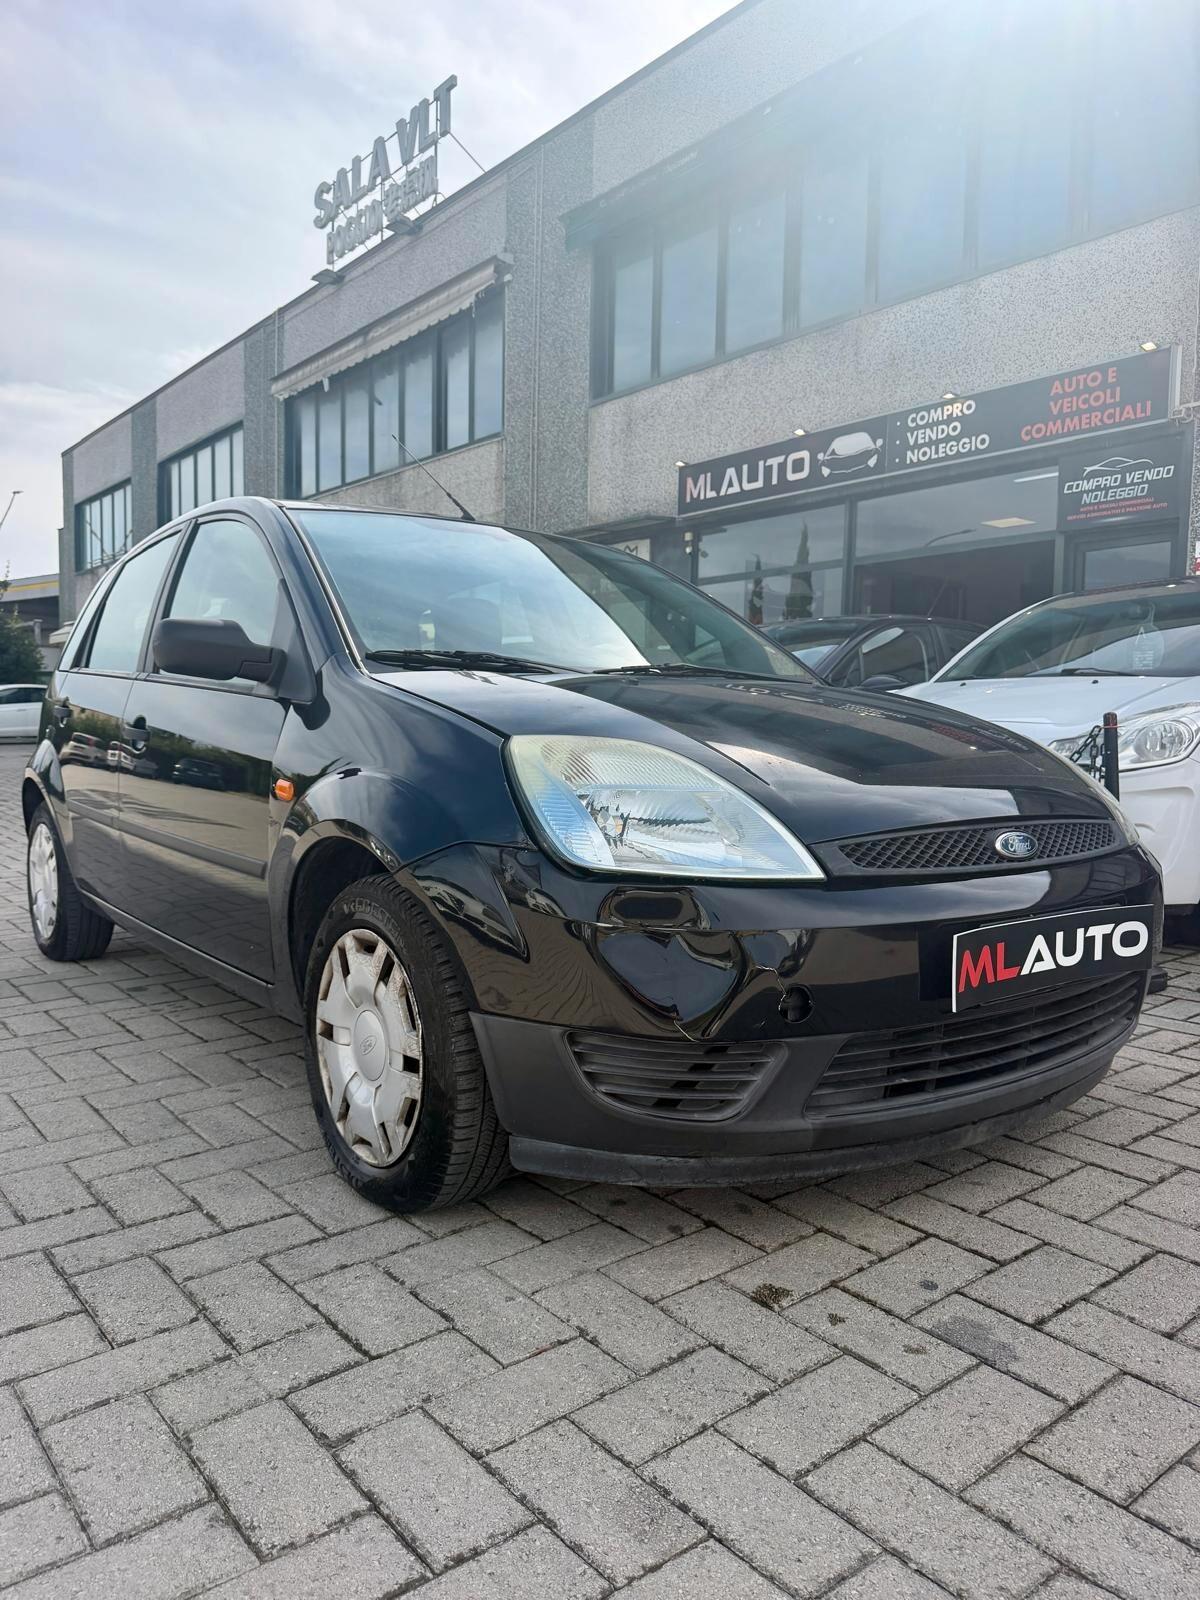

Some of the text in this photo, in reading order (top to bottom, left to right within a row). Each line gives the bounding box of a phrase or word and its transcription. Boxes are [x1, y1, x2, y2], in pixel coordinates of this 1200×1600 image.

[313, 74, 457, 229] SALA VLT
[1050, 367, 1118, 396] AUTO E
[907, 400, 976, 428] COMPRO
[1050, 387, 1121, 416] VEICOLI
[906, 421, 961, 446] VENDO
[1021, 400, 1152, 441] COMMERCIALI
[906, 434, 990, 464] NOLEGGIO
[1064, 465, 1175, 494] COMPRO VENDO
[1081, 484, 1149, 505] NOLEGGIO
